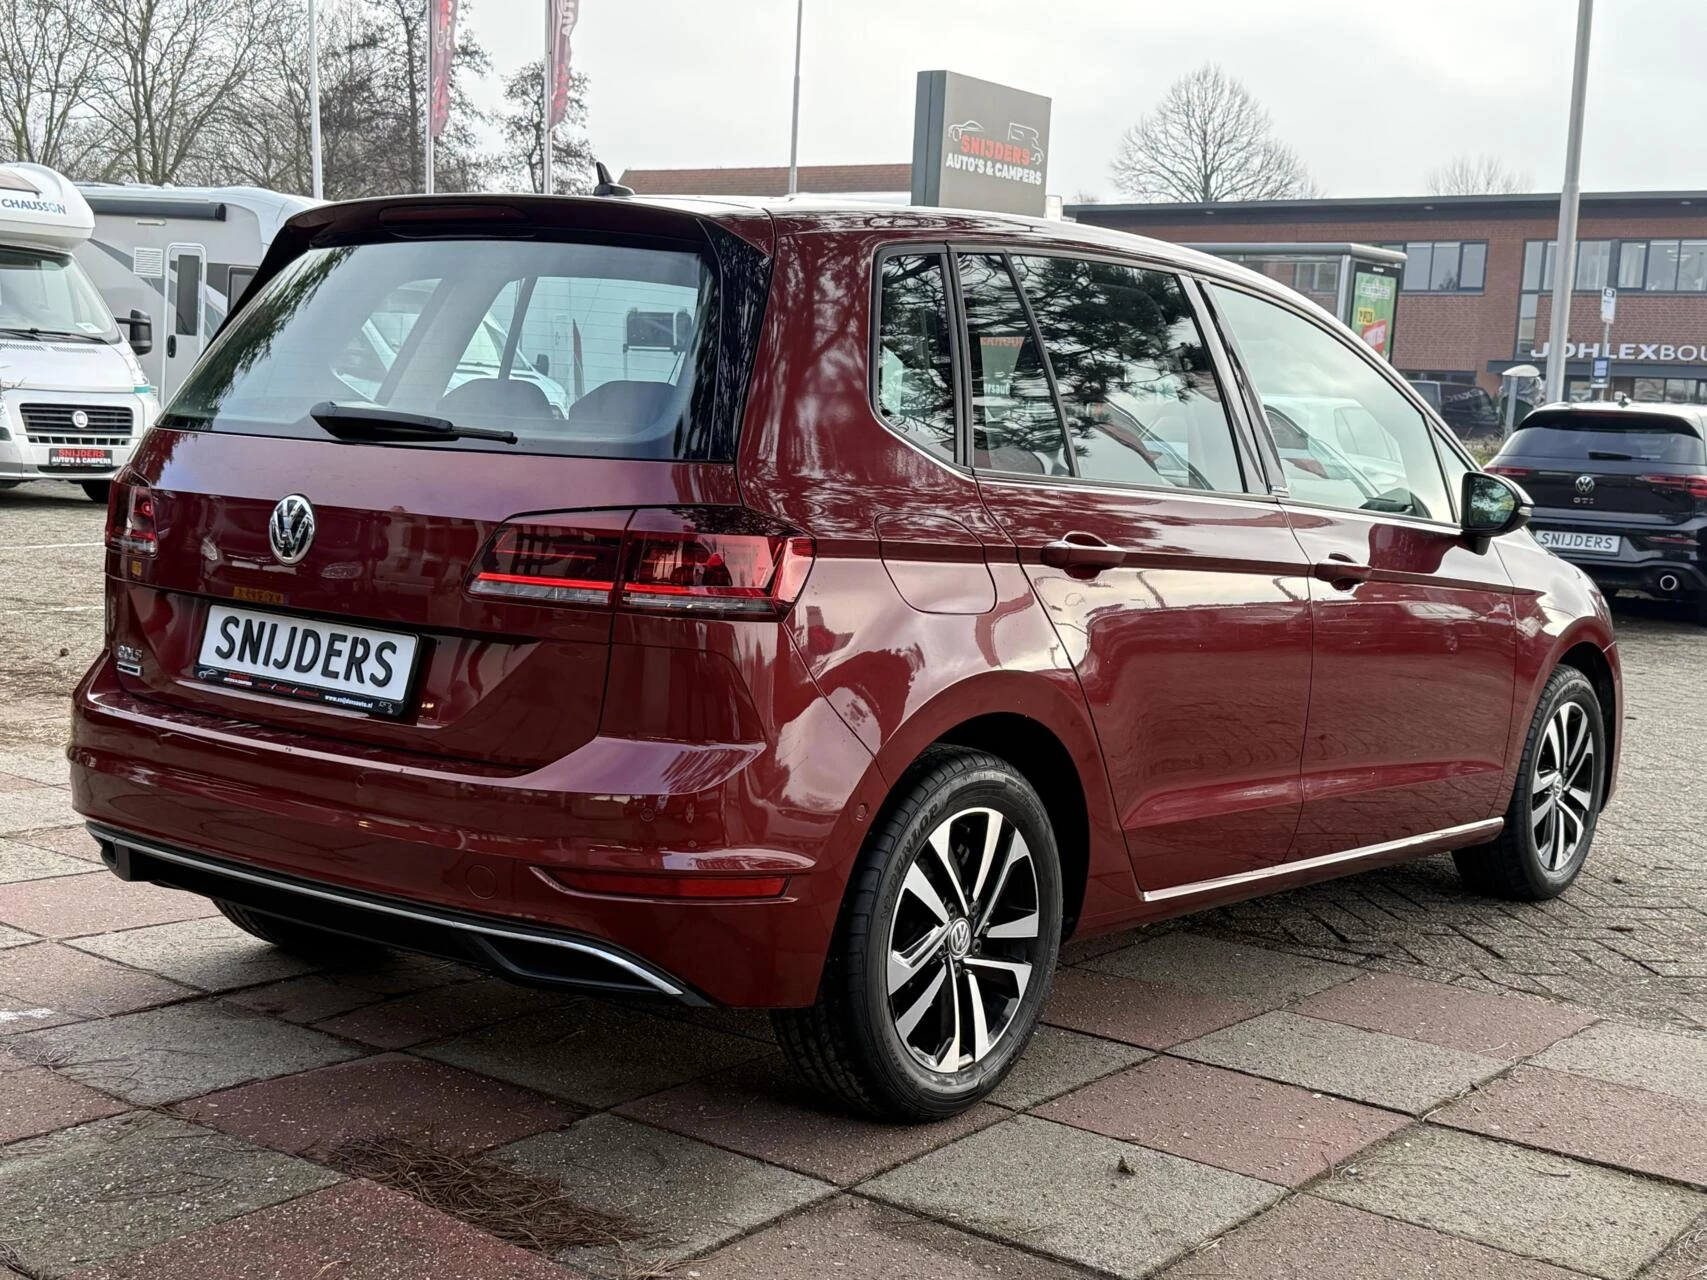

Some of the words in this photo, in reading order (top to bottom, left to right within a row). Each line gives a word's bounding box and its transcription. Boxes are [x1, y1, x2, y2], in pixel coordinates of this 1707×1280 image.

[961, 134, 1030, 166] SNIJDERS
[945, 152, 985, 174] AUTO'S
[985, 161, 994, 176] &
[995, 162, 1042, 186] CAMPERS
[1, 199, 67, 215] CHAUSSON
[58, 449, 105, 458] SNIJDERS
[1541, 532, 1613, 549] SNIJDERS
[215, 615, 398, 688] SNIJDERS
